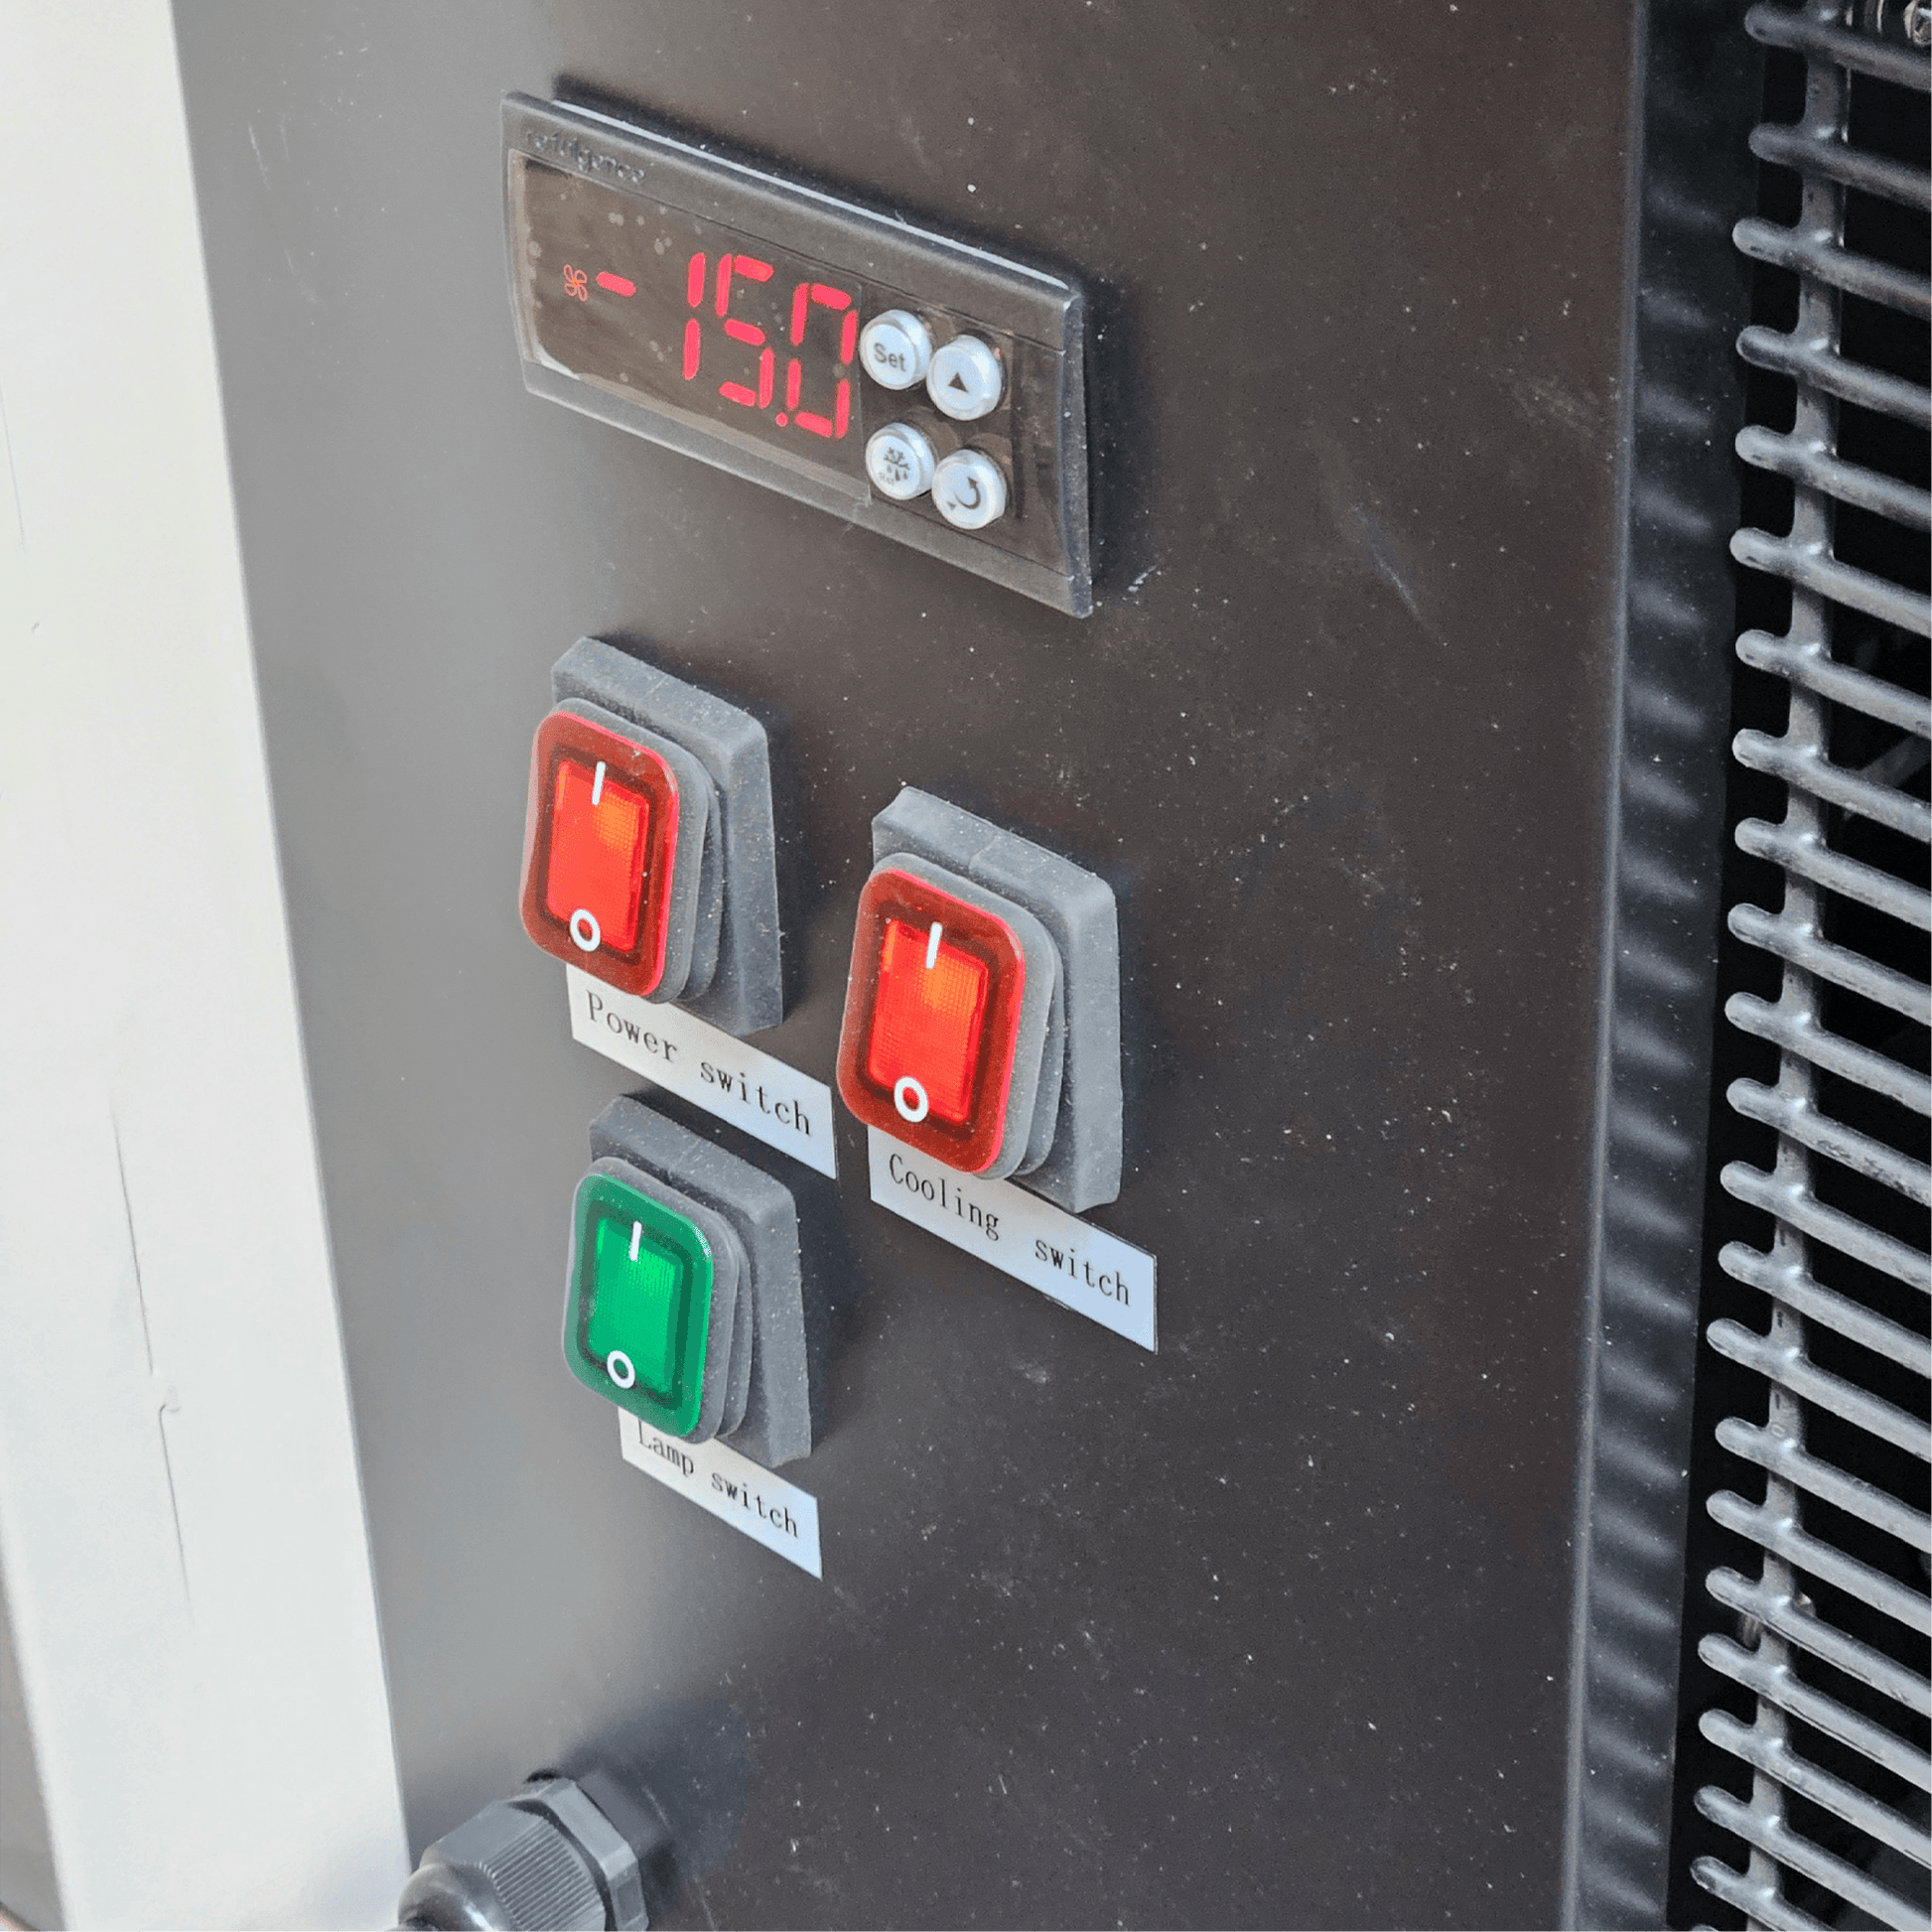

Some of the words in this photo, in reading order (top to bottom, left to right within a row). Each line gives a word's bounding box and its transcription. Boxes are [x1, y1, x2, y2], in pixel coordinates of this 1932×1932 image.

[873, 342, 907, 373] Set
[585, 989, 678, 1063] Power
[700, 1060, 813, 1138] switch
[888, 1153, 1001, 1242] Cooling
[1035, 1238, 1132, 1308] switch
[636, 1419, 695, 1478] Lamp
[710, 1471, 799, 1540] switch
